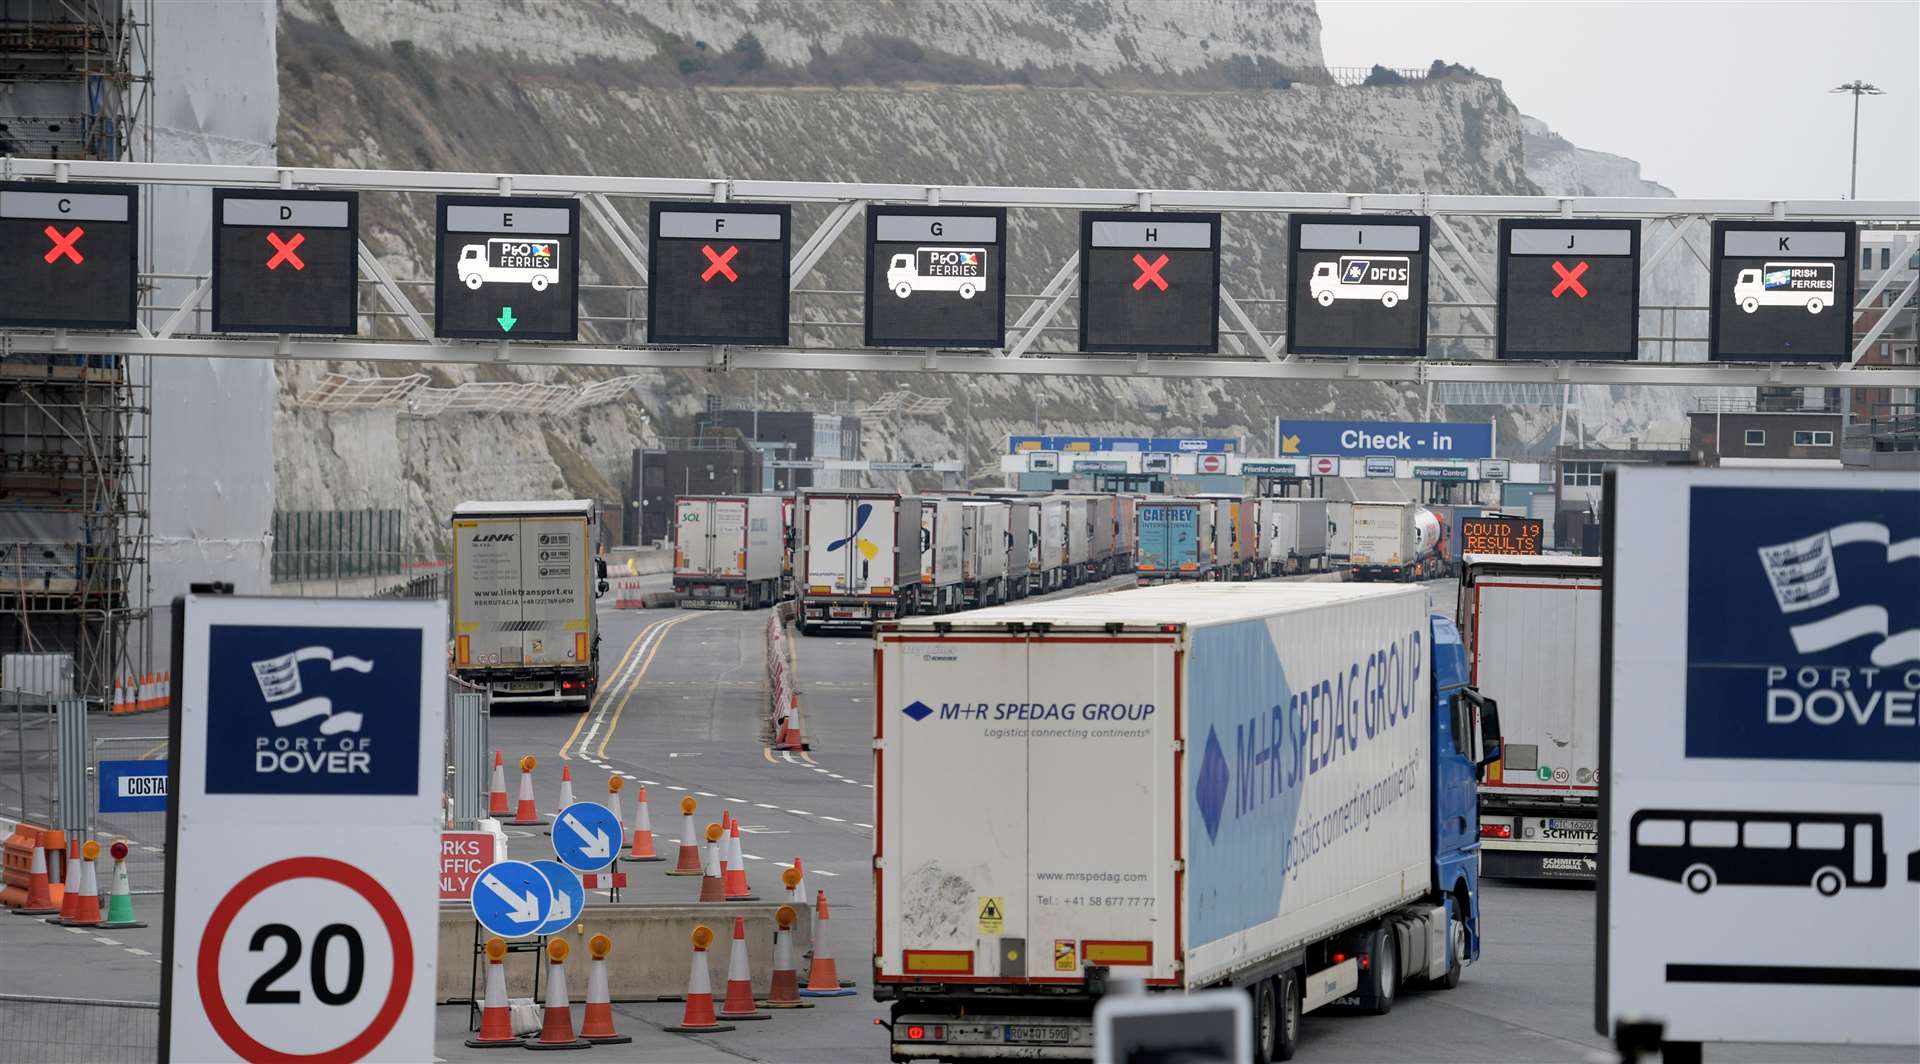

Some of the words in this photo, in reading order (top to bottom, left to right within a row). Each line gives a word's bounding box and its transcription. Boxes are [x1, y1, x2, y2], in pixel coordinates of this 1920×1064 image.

[58, 199, 71, 213] C
[280, 206, 292, 220] D
[503, 213, 513, 227] E
[715, 220, 725, 233] F
[931, 222, 943, 236] G
[1146, 229, 1157, 242] H
[1567, 236, 1575, 249] J
[1779, 237, 1790, 251] K
[502, 243, 531, 256] P&O
[501, 256, 550, 267] FERRIES
[930, 252, 959, 264] P&O
[929, 265, 977, 276] FERRIES
[1370, 267, 1407, 280] DFDS
[1791, 269, 1817, 278] IRISH
[1791, 280, 1832, 289] FERRIES
[1341, 430, 1411, 450] Check
[1432, 431, 1453, 450] in
[1271, 466, 1294, 474] Control
[1415, 468, 1441, 476] Frontier
[1442, 469, 1467, 478] Control
[1143, 509, 1192, 521] CAFFREY
[1463, 523, 1511, 536] COVID
[1521, 524, 1540, 537] 19
[1468, 536, 1534, 550] RESULTS
[474, 587, 574, 598] www.linktransport.eu
[1767, 666, 1880, 689] PORT
[939, 703, 989, 720] M+R
[993, 703, 1077, 721] SPEDAG
[1082, 703, 1156, 721] GROUP
[1766, 688, 1920, 726] DOVE
[1234, 704, 1283, 820] M+R
[1287, 663, 1360, 788] SPEDAG
[1364, 630, 1421, 741] GROUP
[983, 728, 1027, 739] Logistics
[1031, 728, 1088, 739] connecting
[256, 737, 327, 751] PORT
[339, 738, 371, 752] OF
[255, 750, 371, 773] DOVER
[1556, 771, 1567, 779] 50
[1280, 813, 1321, 881] Logistics
[1321, 784, 1371, 849] connecting
[1542, 829, 1599, 840] SCHMITZ
[1542, 857, 1582, 866] SCHMITZ
[1036, 871, 1148, 883] www.mrspedag.com
[1064, 896, 1084, 906] +41
[1089, 896, 1102, 907] 58
[1105, 897, 1125, 907] 677
[1127, 897, 1140, 907] 77
[1143, 898, 1156, 908] 77
[246, 923, 365, 1006] 20
[1049, 1028, 1067, 1040] 590
